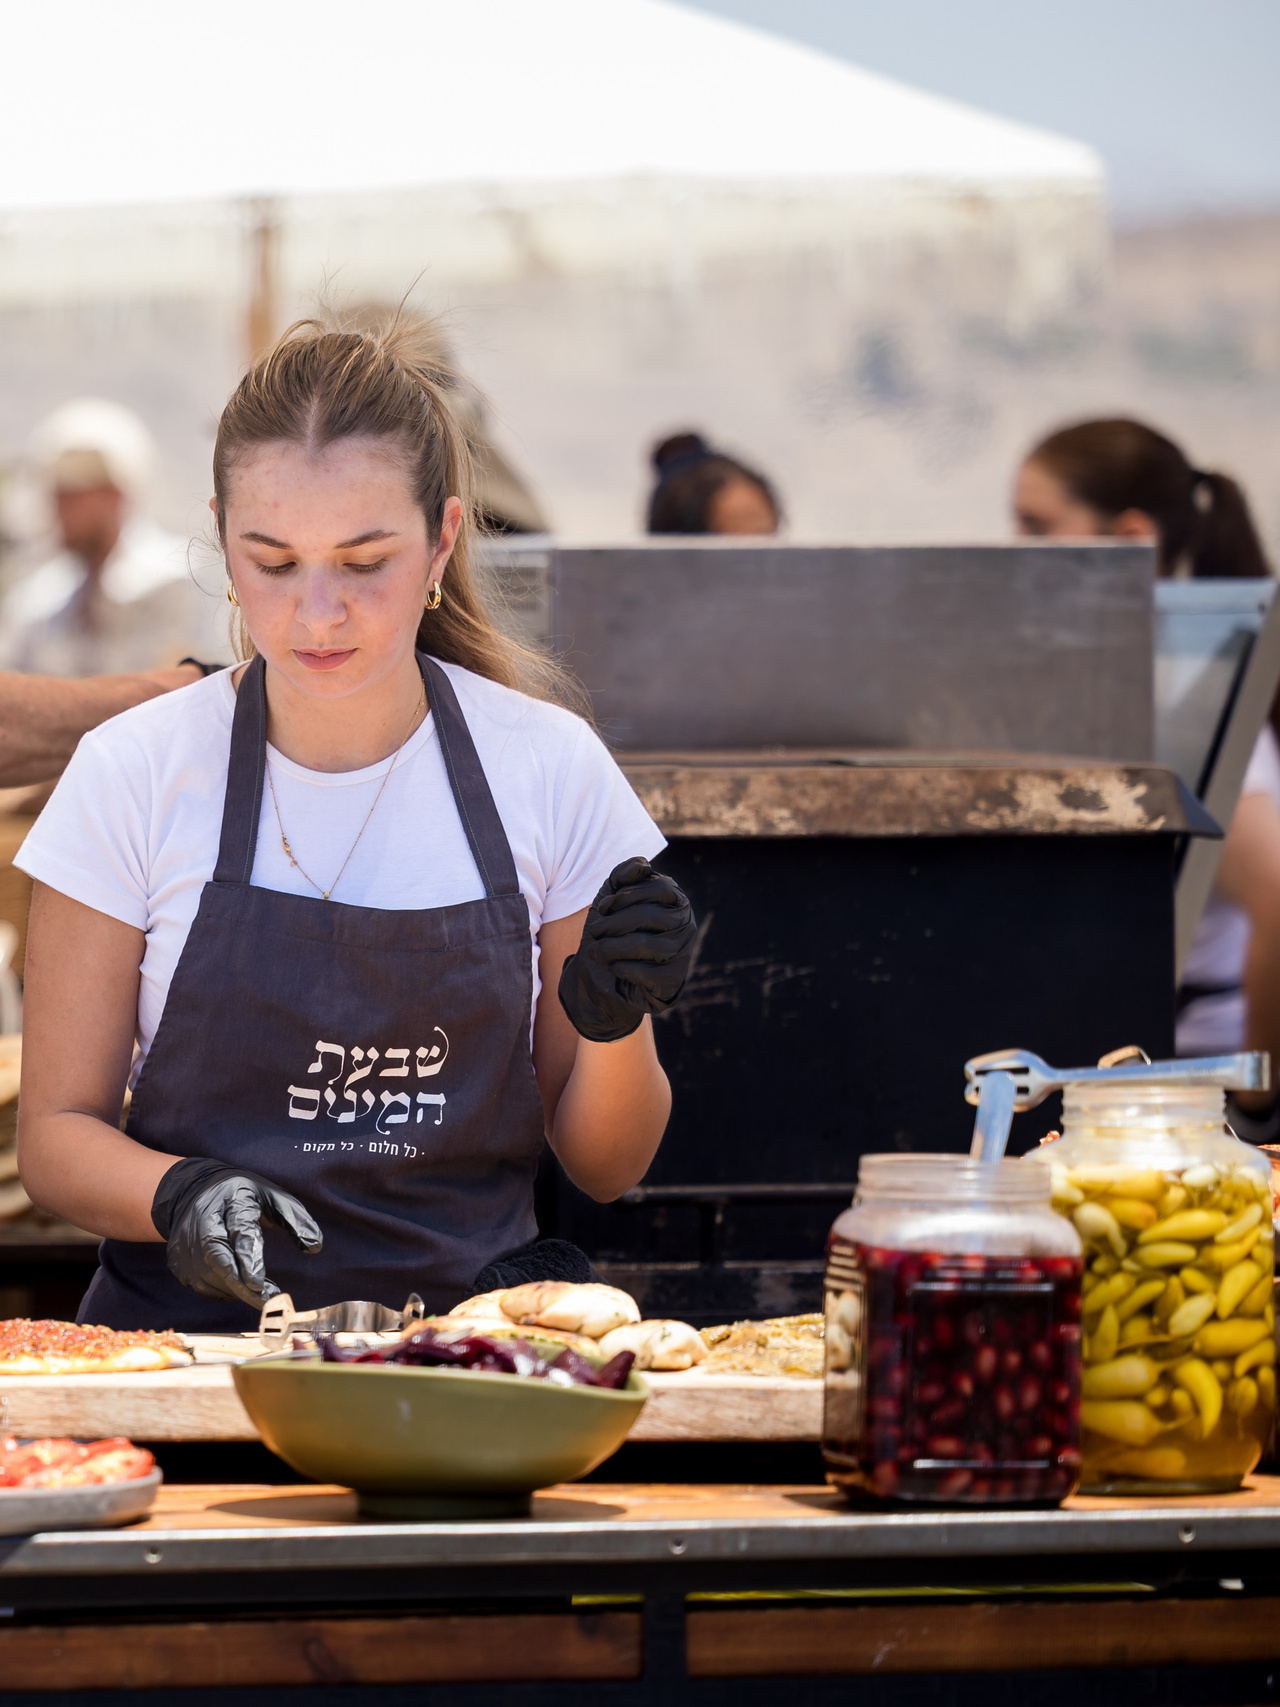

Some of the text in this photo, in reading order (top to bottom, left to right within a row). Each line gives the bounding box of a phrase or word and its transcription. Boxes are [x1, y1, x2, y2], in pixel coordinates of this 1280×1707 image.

[307, 1025, 450, 1098] שבעת
[287, 1084, 447, 1135] המינים
[302, 1140, 418, 1158] כל חלום כל מקום
